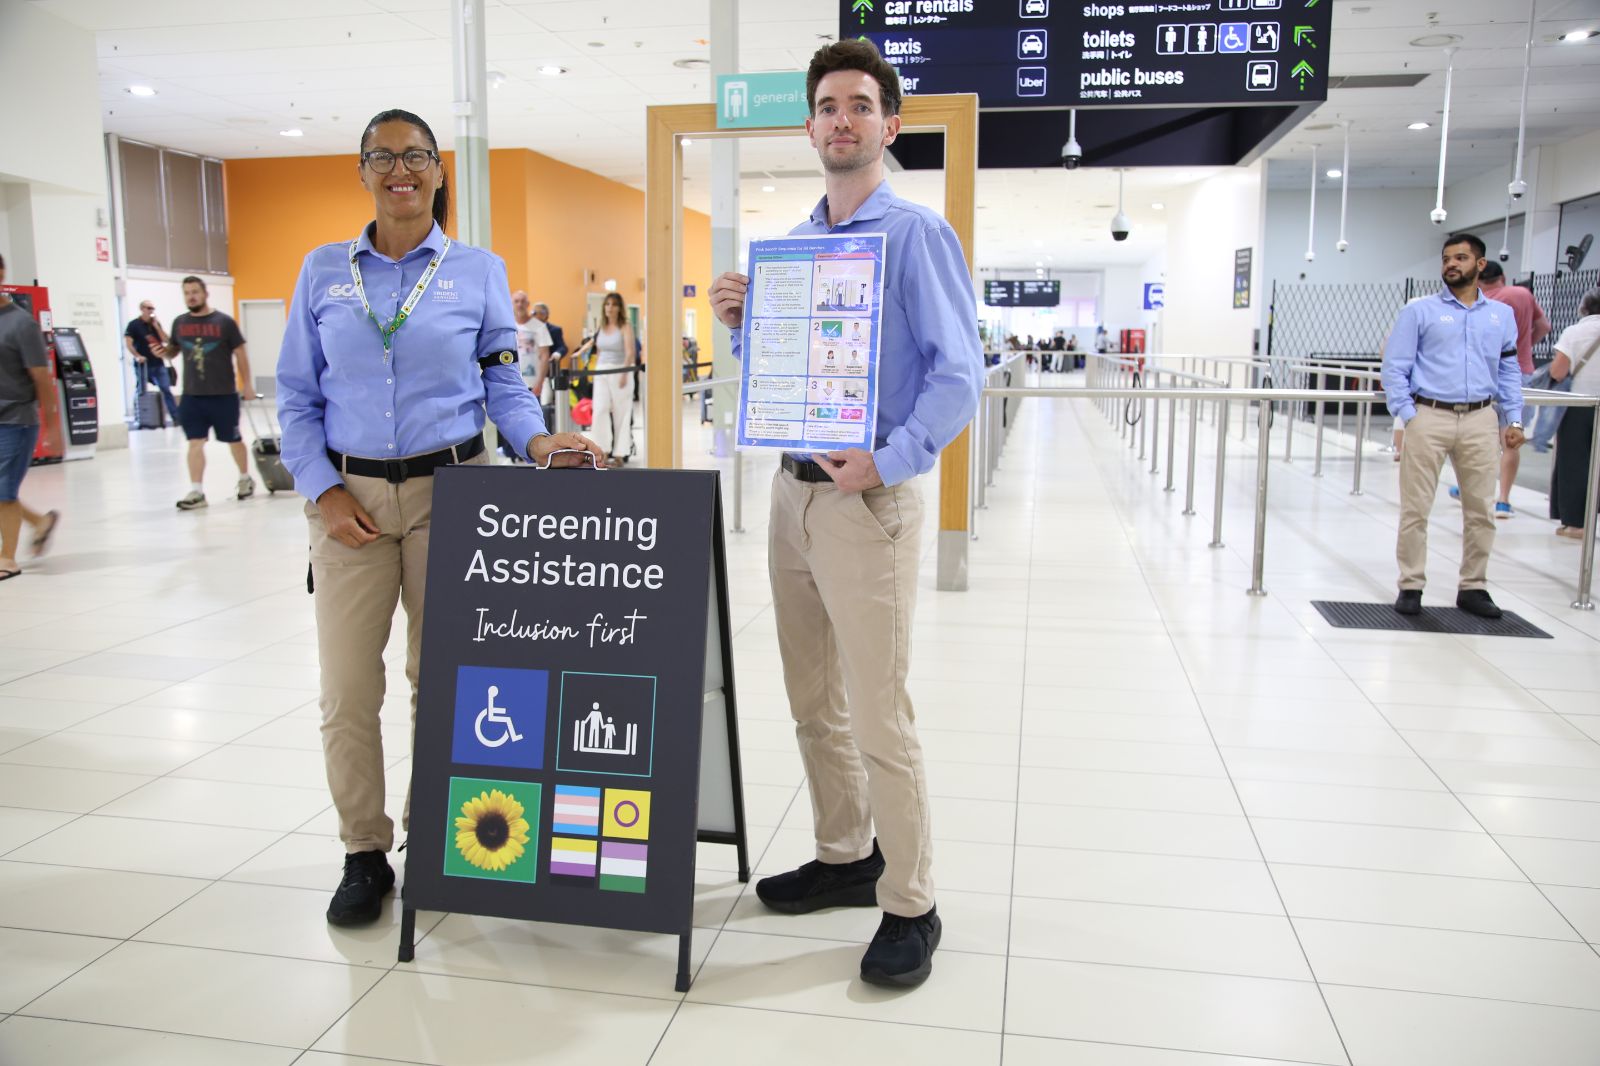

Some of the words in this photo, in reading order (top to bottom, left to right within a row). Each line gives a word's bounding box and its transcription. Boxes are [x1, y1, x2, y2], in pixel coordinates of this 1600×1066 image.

[885, 0, 912, 15] car
[916, 0, 974, 14] rentals
[1083, 3, 1125, 19] shops
[884, 38, 922, 55] taxis
[1083, 30, 1136, 48] toilets
[1020, 77, 1044, 88] Uber
[1080, 67, 1131, 90] public
[1134, 67, 1185, 85] buses
[753, 90, 798, 107] general
[476, 504, 658, 551] Screening
[464, 549, 664, 590] Assistance
[473, 607, 580, 642] Inclusion
[586, 608, 648, 648] first
